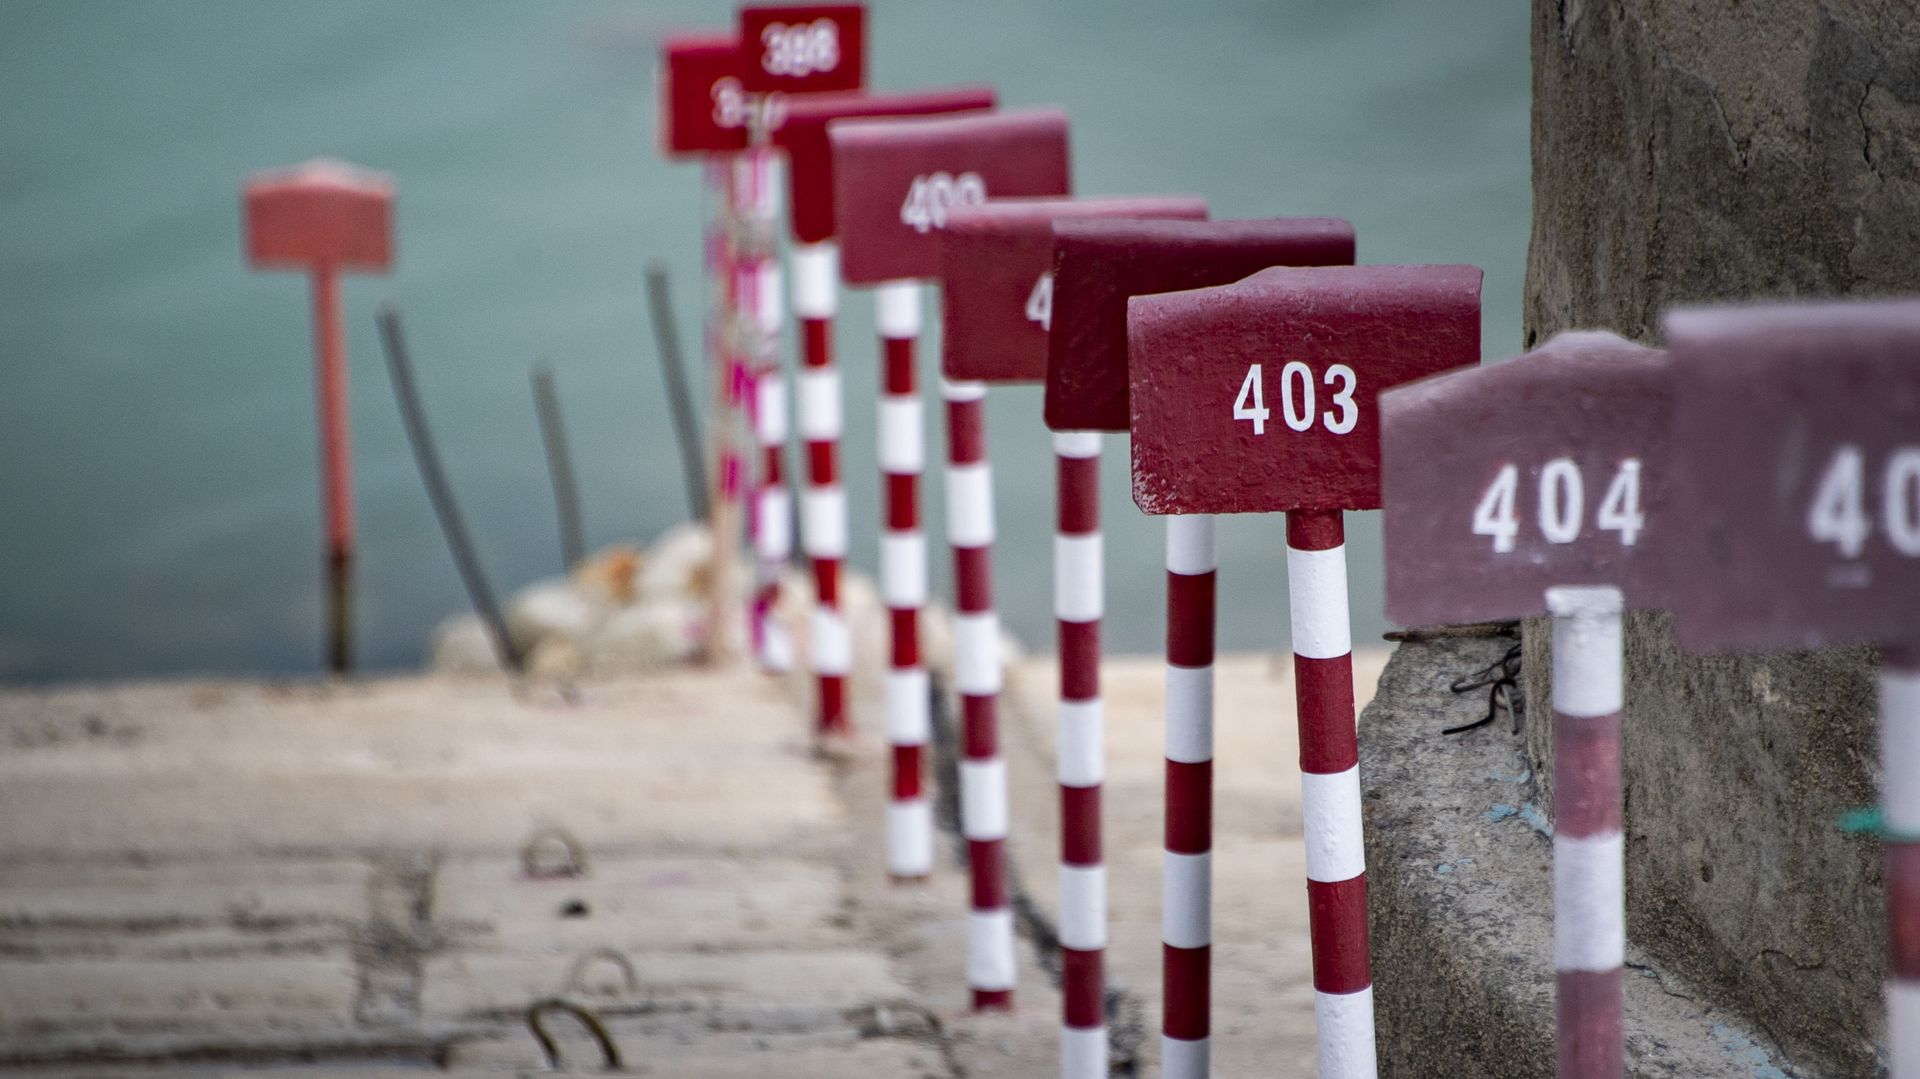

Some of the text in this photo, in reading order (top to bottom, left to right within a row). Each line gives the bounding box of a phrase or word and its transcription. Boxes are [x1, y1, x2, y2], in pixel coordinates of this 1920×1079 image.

[1233, 361, 1358, 435] 403
[1472, 457, 1645, 553] 404
[1808, 444, 1920, 558] 40
